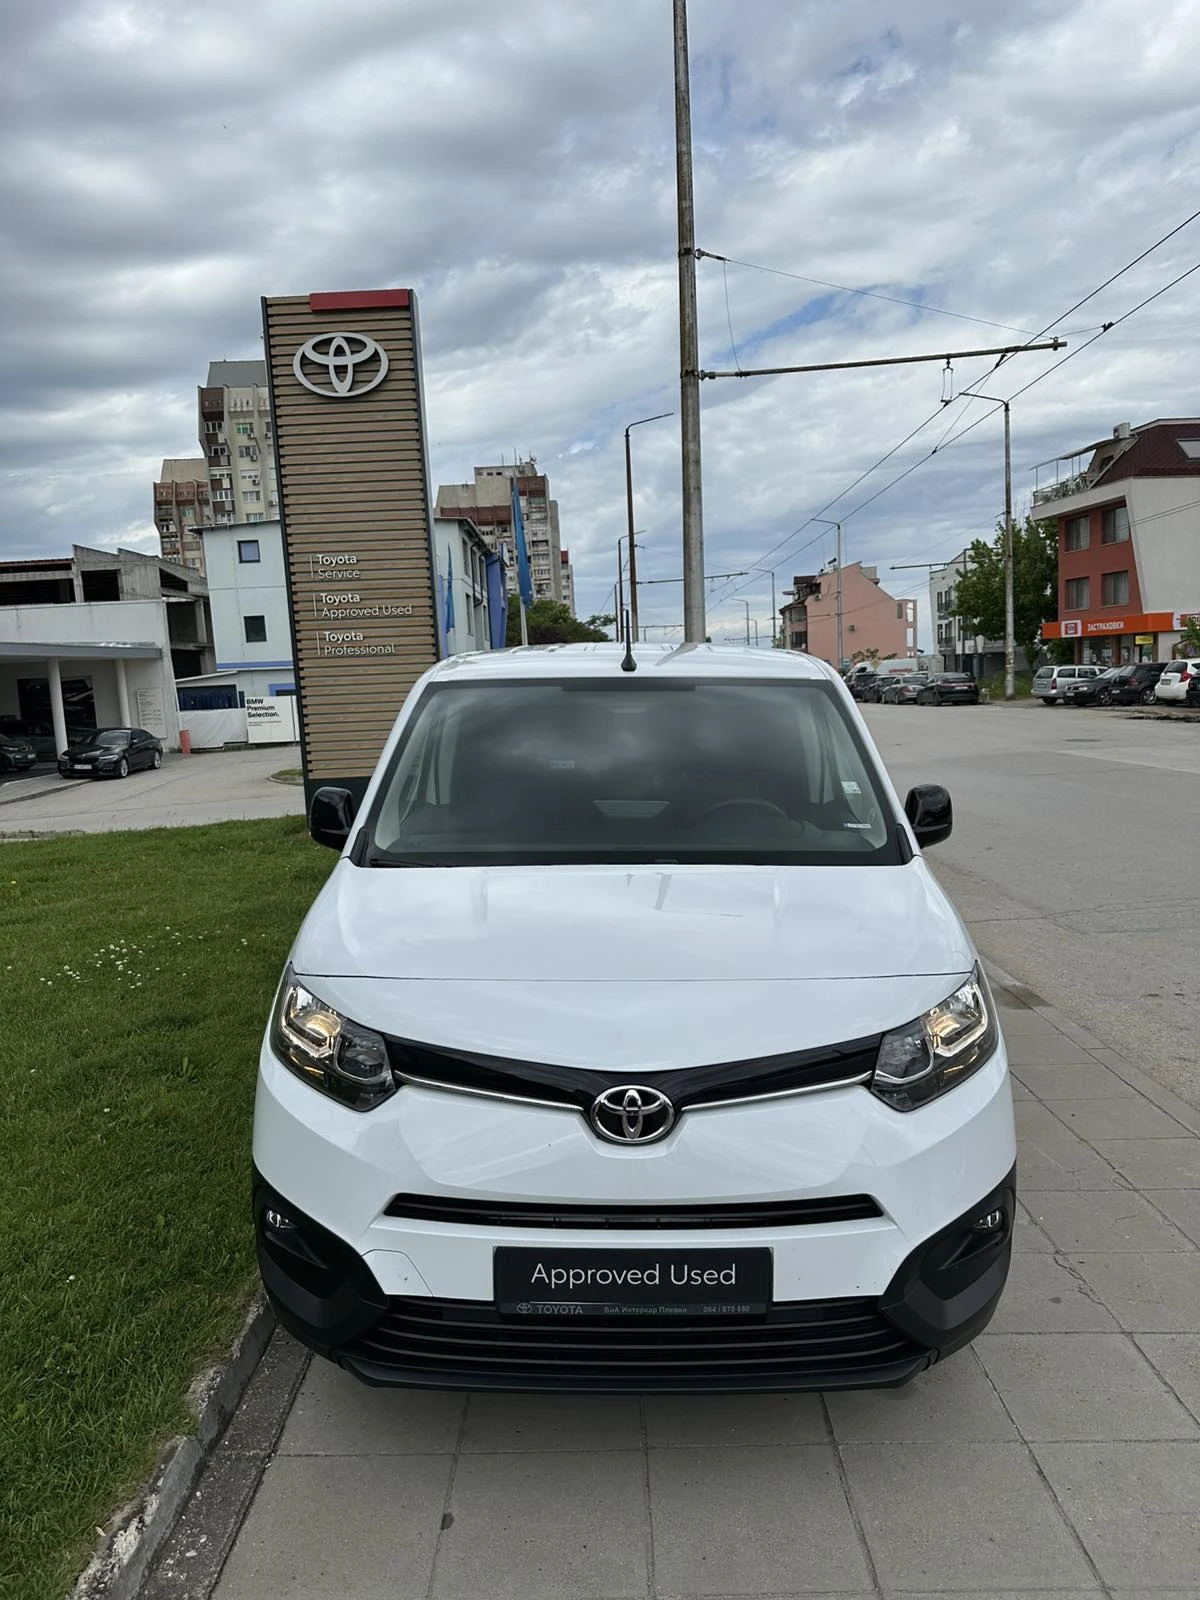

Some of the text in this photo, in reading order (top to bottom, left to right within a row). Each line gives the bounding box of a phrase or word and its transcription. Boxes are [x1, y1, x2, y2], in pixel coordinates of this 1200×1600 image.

[317, 554, 358, 567] Toyota
[318, 568, 361, 579] Service
[320, 593, 361, 605] Toyota
[322, 604, 413, 619] Approved Used
[323, 631, 364, 644] Toyota
[324, 643, 395, 656] Professional
[530, 1262, 737, 1289] Approved Used
[536, 1304, 584, 1315] TOYOTA
[621, 1306, 658, 1314] Интеркар
